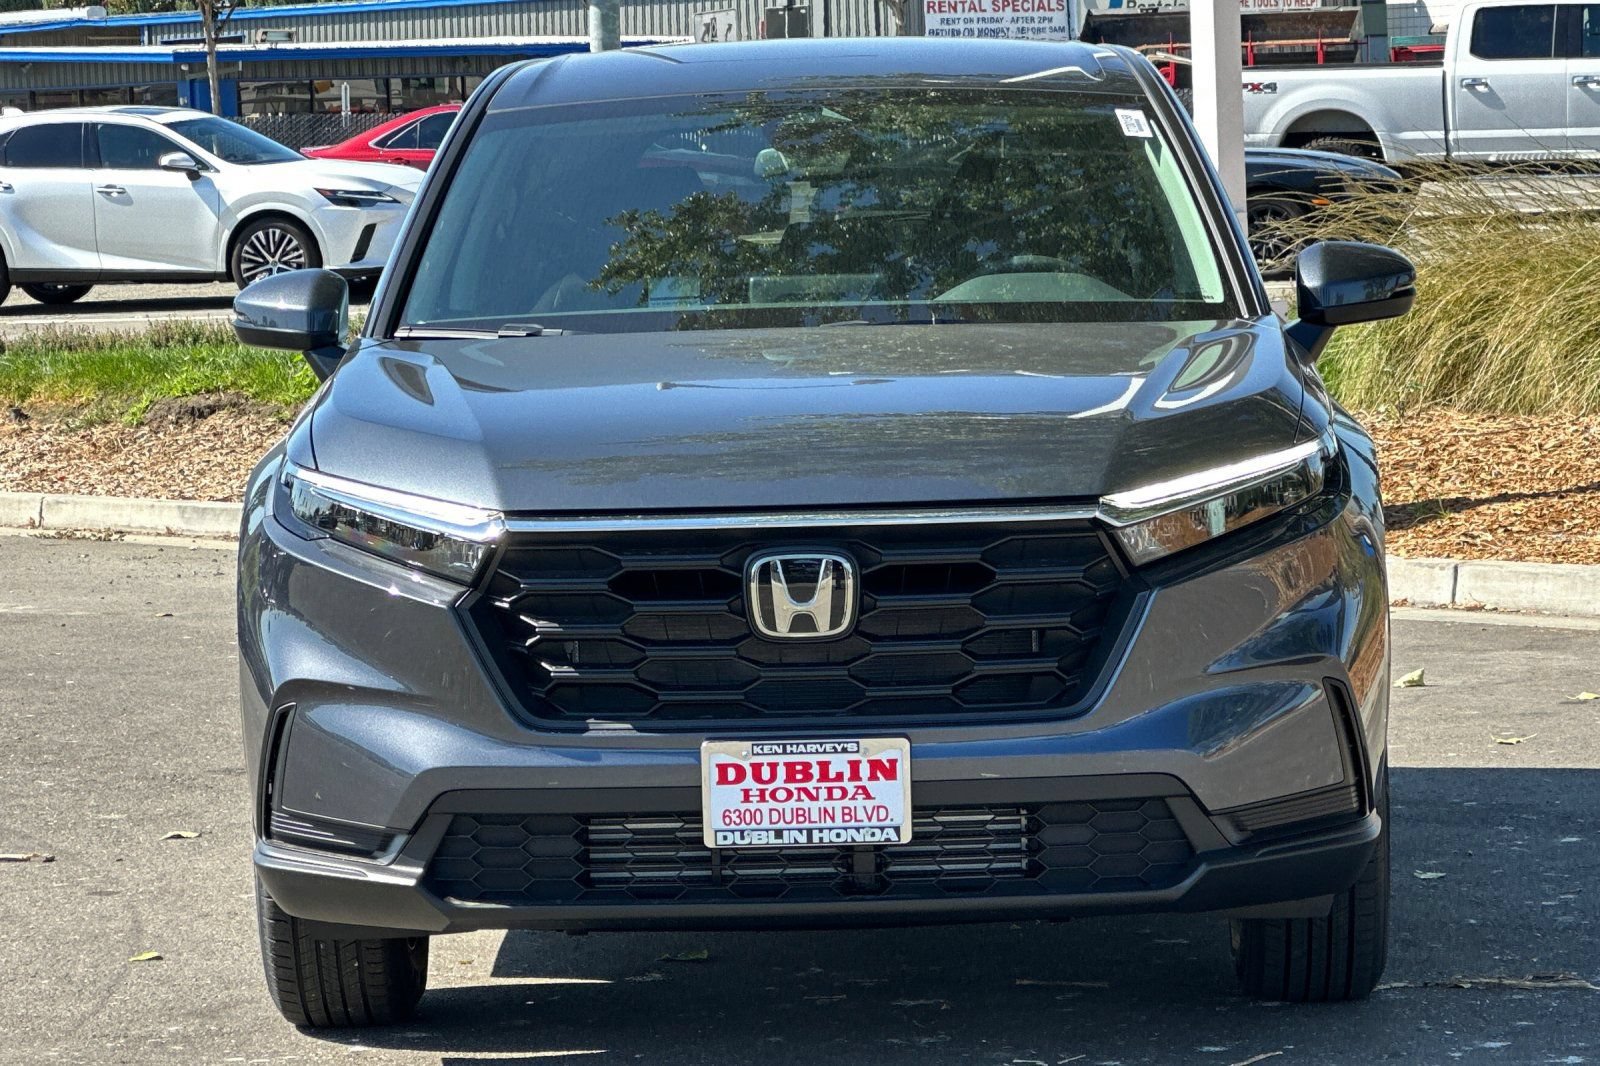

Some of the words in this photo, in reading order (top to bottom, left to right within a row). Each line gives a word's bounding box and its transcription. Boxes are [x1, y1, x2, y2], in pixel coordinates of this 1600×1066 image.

[926, 0, 987, 14] RENTAL
[991, 0, 1065, 13] SPECIALS
[940, 17, 961, 25] RENT
[963, 17, 974, 25] ON
[976, 16, 1004, 24] FRIDAY
[1010, 16, 1035, 24] AFTER
[1037, 16, 1053, 24] 2PM
[752, 743, 783, 755] KEN
[784, 742, 859, 754] HARVEY'S
[715, 758, 898, 786] DUBLIN
[740, 785, 876, 804] HONDA
[722, 808, 763, 827] 6300
[768, 806, 836, 825] DUBLIN
[841, 805, 894, 824] BLVD.
[716, 829, 808, 846] DUBLIN
[812, 827, 899, 845] HONDA
